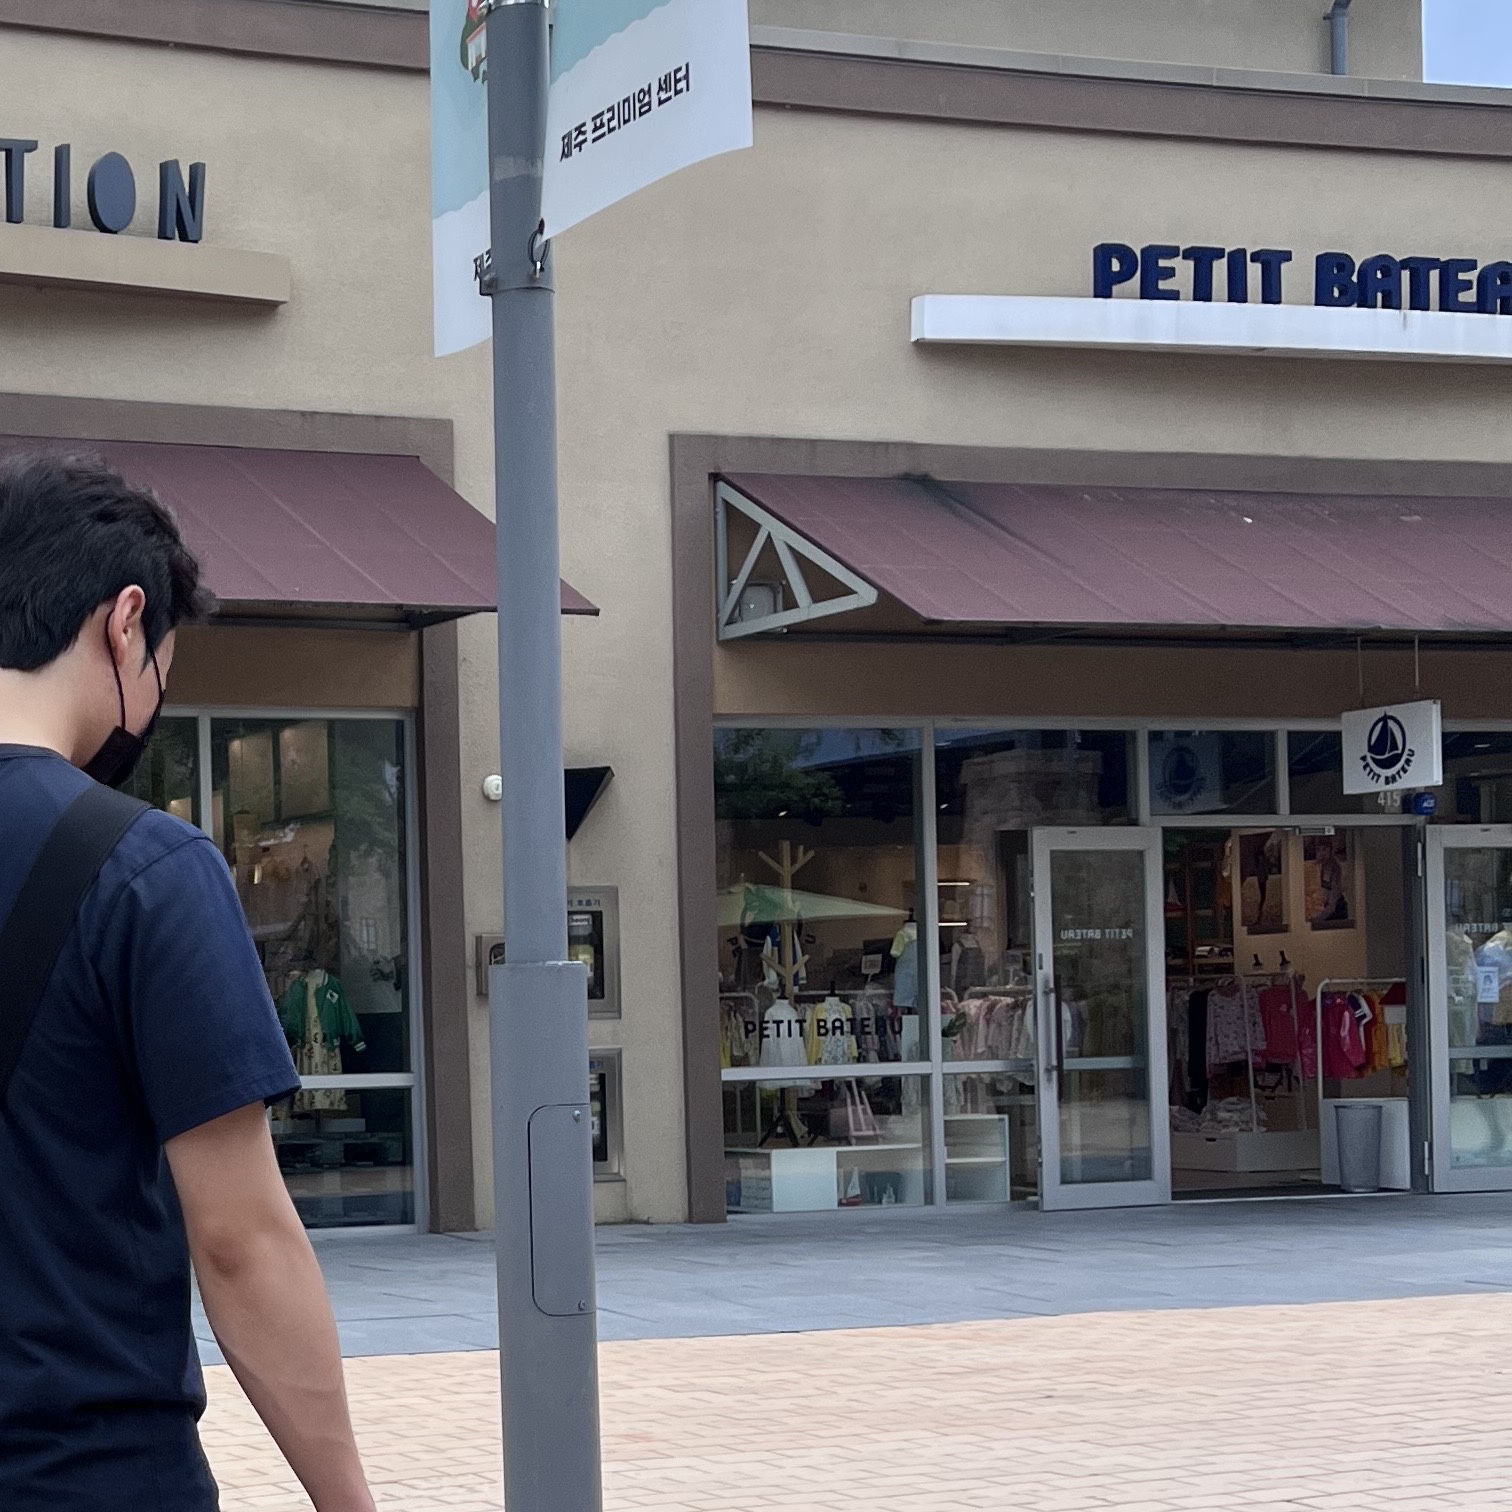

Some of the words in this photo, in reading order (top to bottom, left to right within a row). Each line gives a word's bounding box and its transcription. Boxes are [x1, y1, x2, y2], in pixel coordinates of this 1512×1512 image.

[559, 121, 588, 163] 제주
[591, 82, 653, 145] 프리미엄
[656, 61, 691, 108] 센터
[1092, 242, 1293, 305] PETIT
[1359, 755, 1382, 784] PETIT
[1384, 748, 1416, 786] BATEAU
[1377, 791, 1401, 807] 415
[743, 1019, 807, 1040] PETIT
